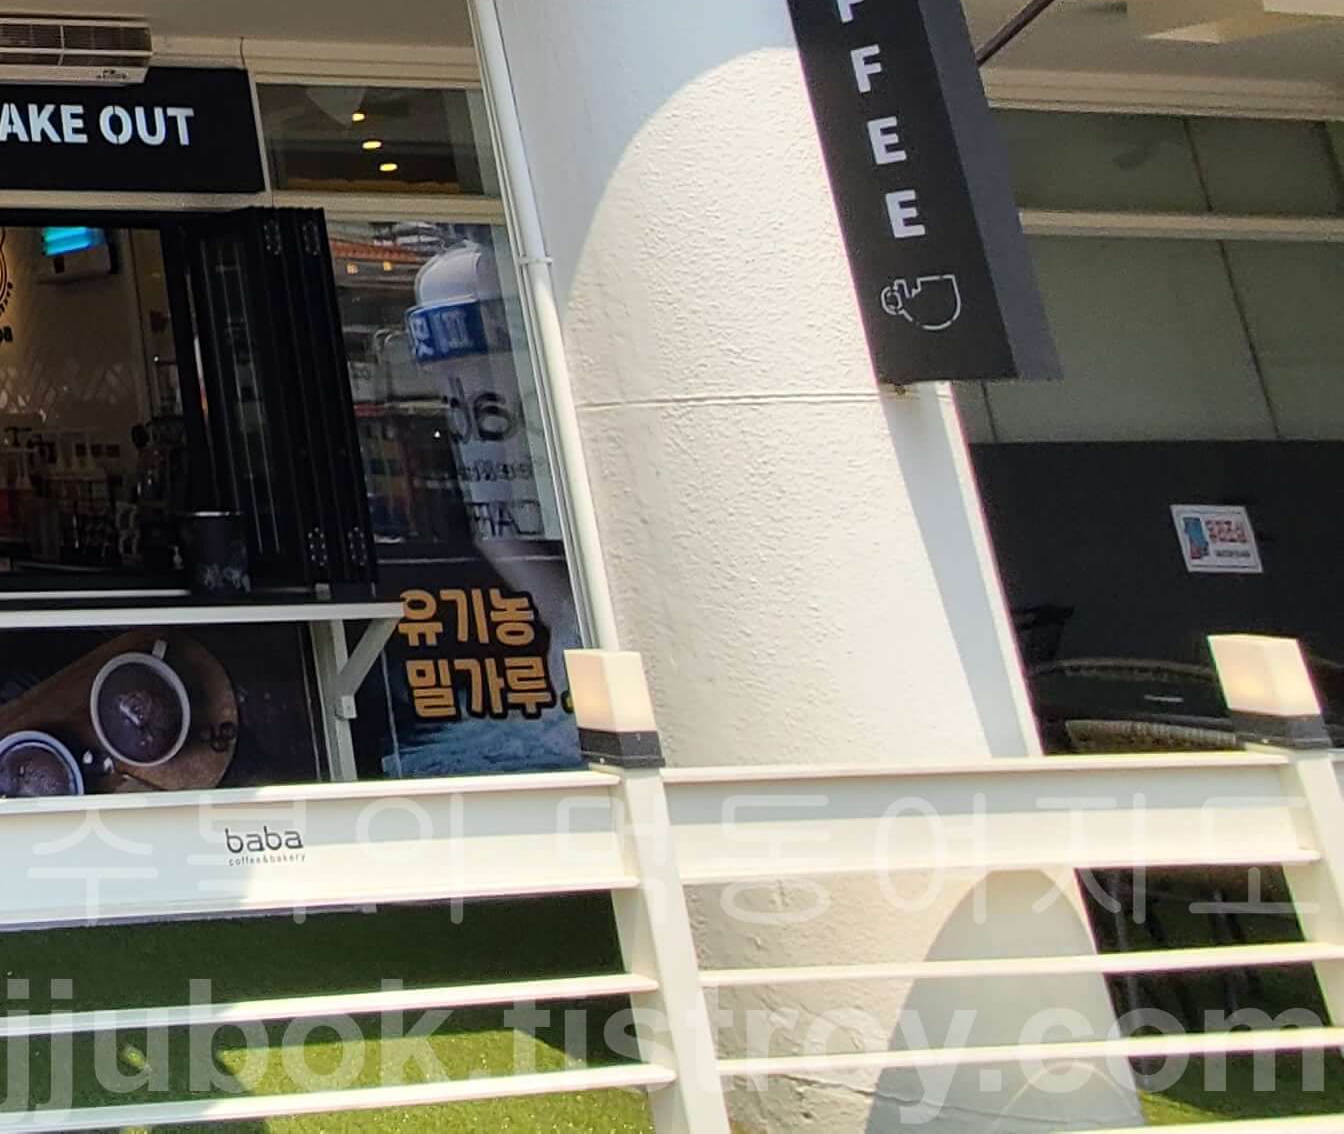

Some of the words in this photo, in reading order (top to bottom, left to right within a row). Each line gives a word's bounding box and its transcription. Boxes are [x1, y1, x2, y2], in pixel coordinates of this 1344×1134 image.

[99, 104, 195, 147] OUT
[398, 589, 536, 647] 유기농
[407, 657, 554, 717] 밀가루
[224, 825, 304, 854] baba
[228, 854, 306, 867] coffee&bakery
